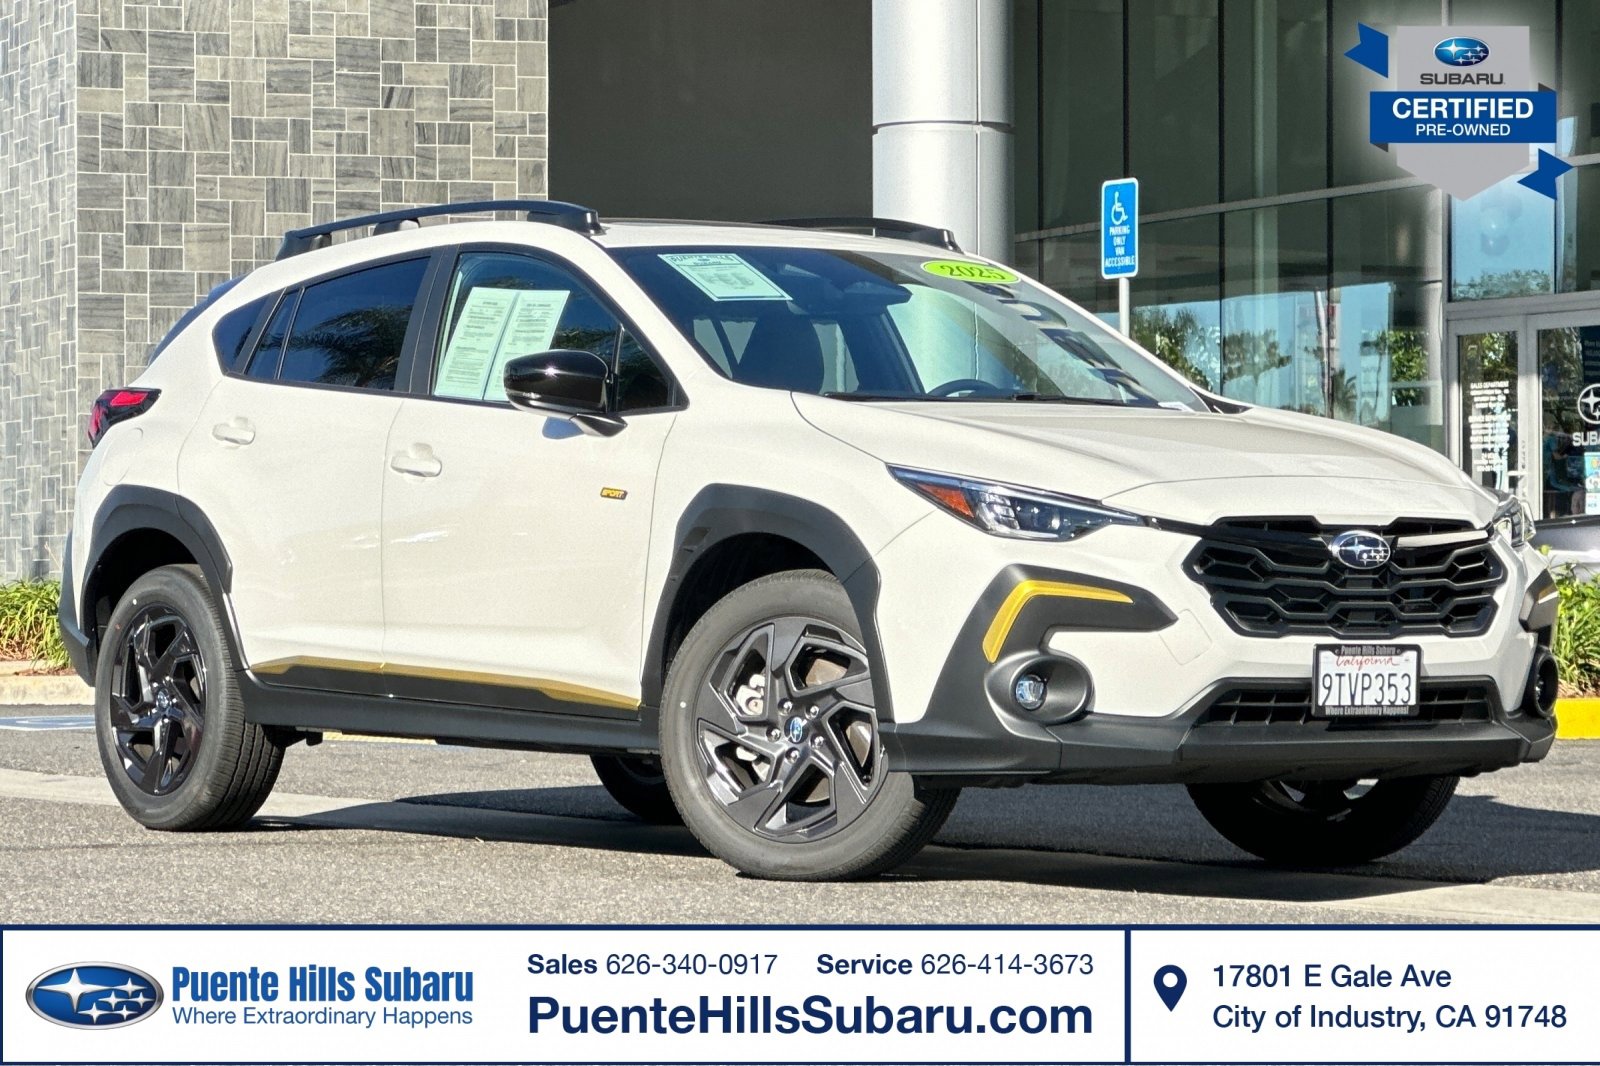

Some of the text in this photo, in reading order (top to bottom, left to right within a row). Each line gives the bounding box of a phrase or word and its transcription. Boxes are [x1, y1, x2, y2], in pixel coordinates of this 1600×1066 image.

[1109, 225, 1131, 236] PARKING
[1113, 236, 1126, 246] ONLY
[1115, 246, 1125, 256] VAN
[1104, 256, 1135, 268] ACCESSIBLE
[939, 264, 1006, 280] 2025
[1572, 431, 1600, 447] SUB
[601, 488, 625, 499] SPORT
[1341, 645, 1396, 655] Puente Hills Subaru
[1336, 655, 1400, 671] California
[1322, 672, 1412, 706] 9TVP353
[1325, 705, 1344, 716] Where
[1344, 705, 1383, 716] Extraordinary
